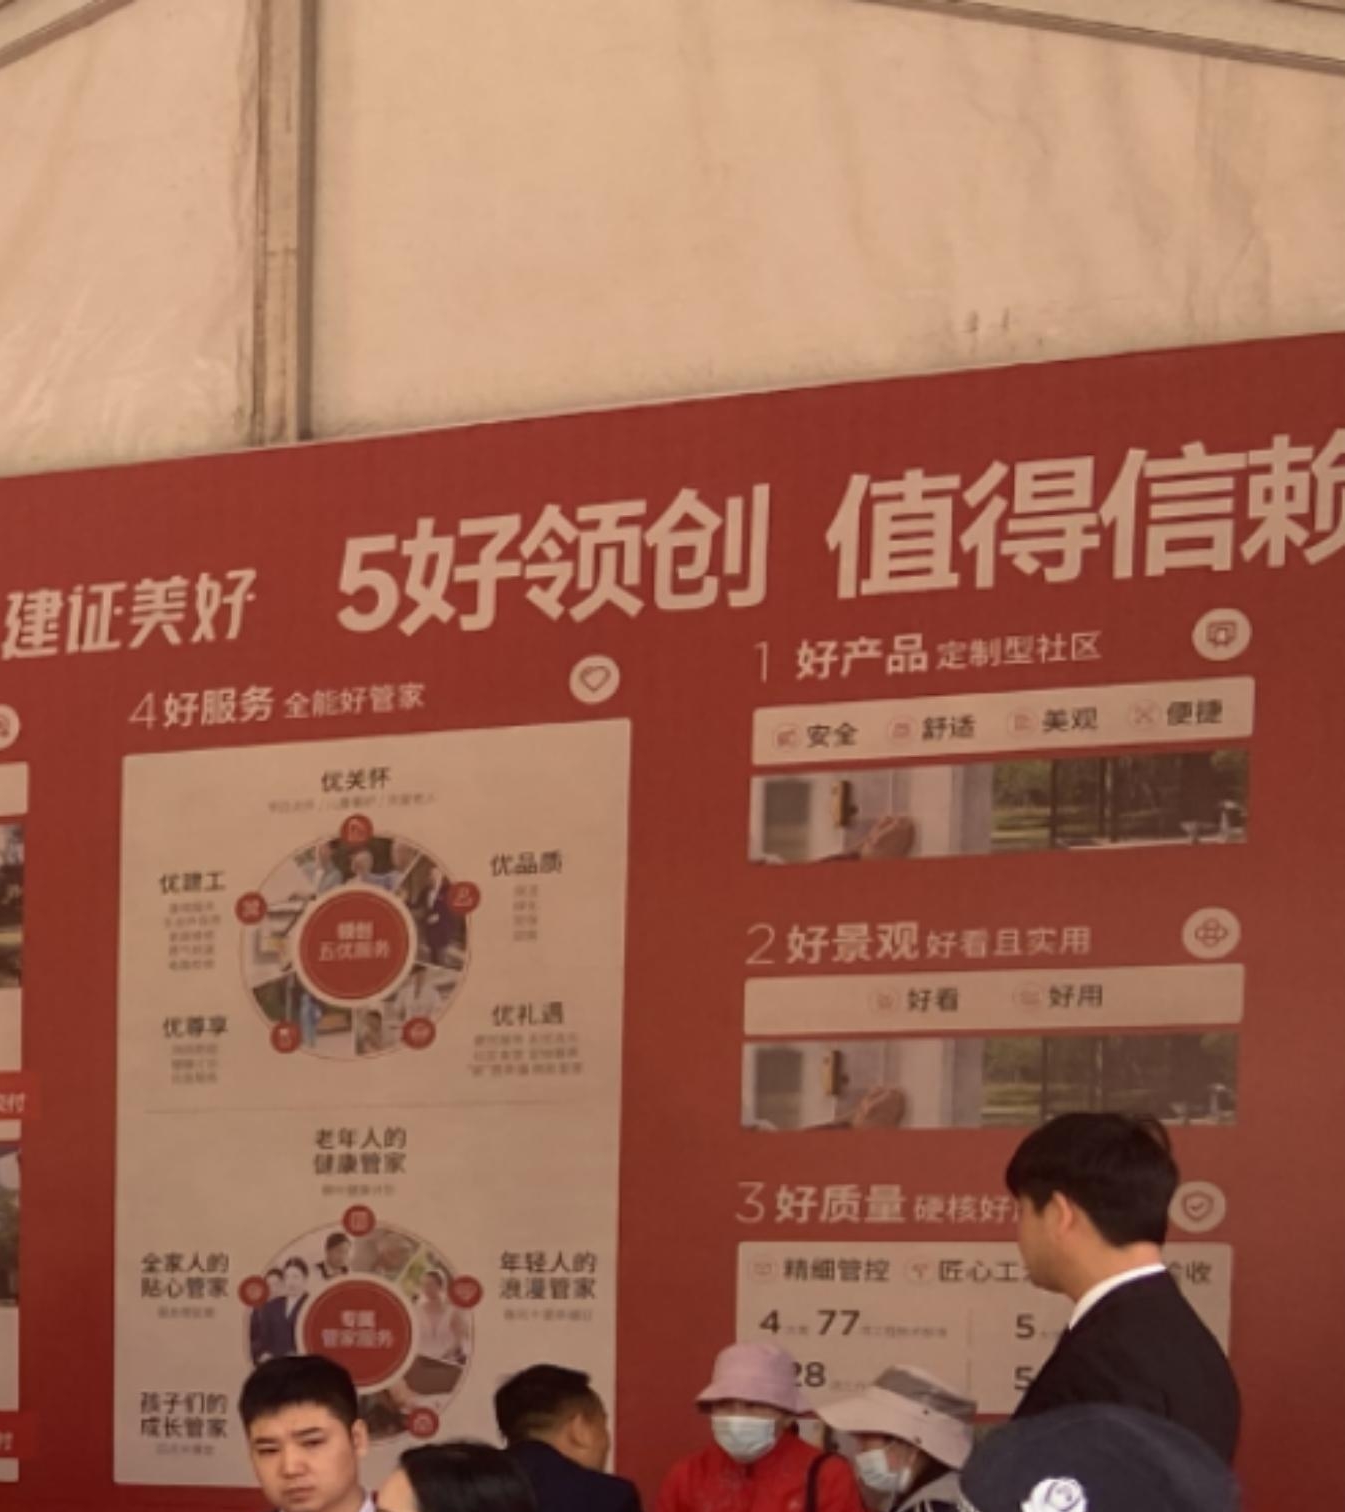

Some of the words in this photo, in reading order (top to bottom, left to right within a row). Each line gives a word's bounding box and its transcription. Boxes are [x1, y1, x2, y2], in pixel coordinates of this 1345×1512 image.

[338, 480, 771, 636] 5好领创
[825, 428, 1345, 600] 值得信赖
[0, 568, 258, 661] 建证美好
[796, 632, 930, 680] 好产品
[935, 630, 1103, 670] 定制型社区
[284, 681, 426, 720] 全能好管家
[806, 722, 859, 748] 安全
[922, 714, 977, 741] 舒适
[1043, 706, 1099, 734] 美观
[1166, 699, 1223, 727] 便捷
[321, 767, 392, 794] 优关怀
[489, 850, 564, 877] 优品质
[159, 871, 227, 895] 优建工
[925, 925, 1092, 959] 好看且实用
[907, 987, 960, 1013] 好看
[1048, 983, 1104, 1010] 好用
[162, 1015, 229, 1039] 优尊享
[491, 1001, 565, 1027] 优礼遇
[314, 1126, 408, 1151] 老年人的
[314, 1151, 408, 1176] 健康管家
[774, 1184, 906, 1224] 好质量
[914, 1193, 1023, 1224] 硬核好
[139, 1252, 231, 1275] 全家人的
[498, 1250, 598, 1275] 年轻人的
[783, 1257, 891, 1282] 精细管控
[938, 1259, 1030, 1283] 匠心工
[139, 1276, 231, 1301] 贴心管家
[498, 1276, 598, 1301] 浪漫管家
[759, 1309, 782, 1335] 4
[816, 1309, 861, 1336] 77
[1016, 1314, 1036, 1340] 5
[139, 1390, 230, 1415] 孩子们的
[139, 1415, 230, 1439] 成长管家
